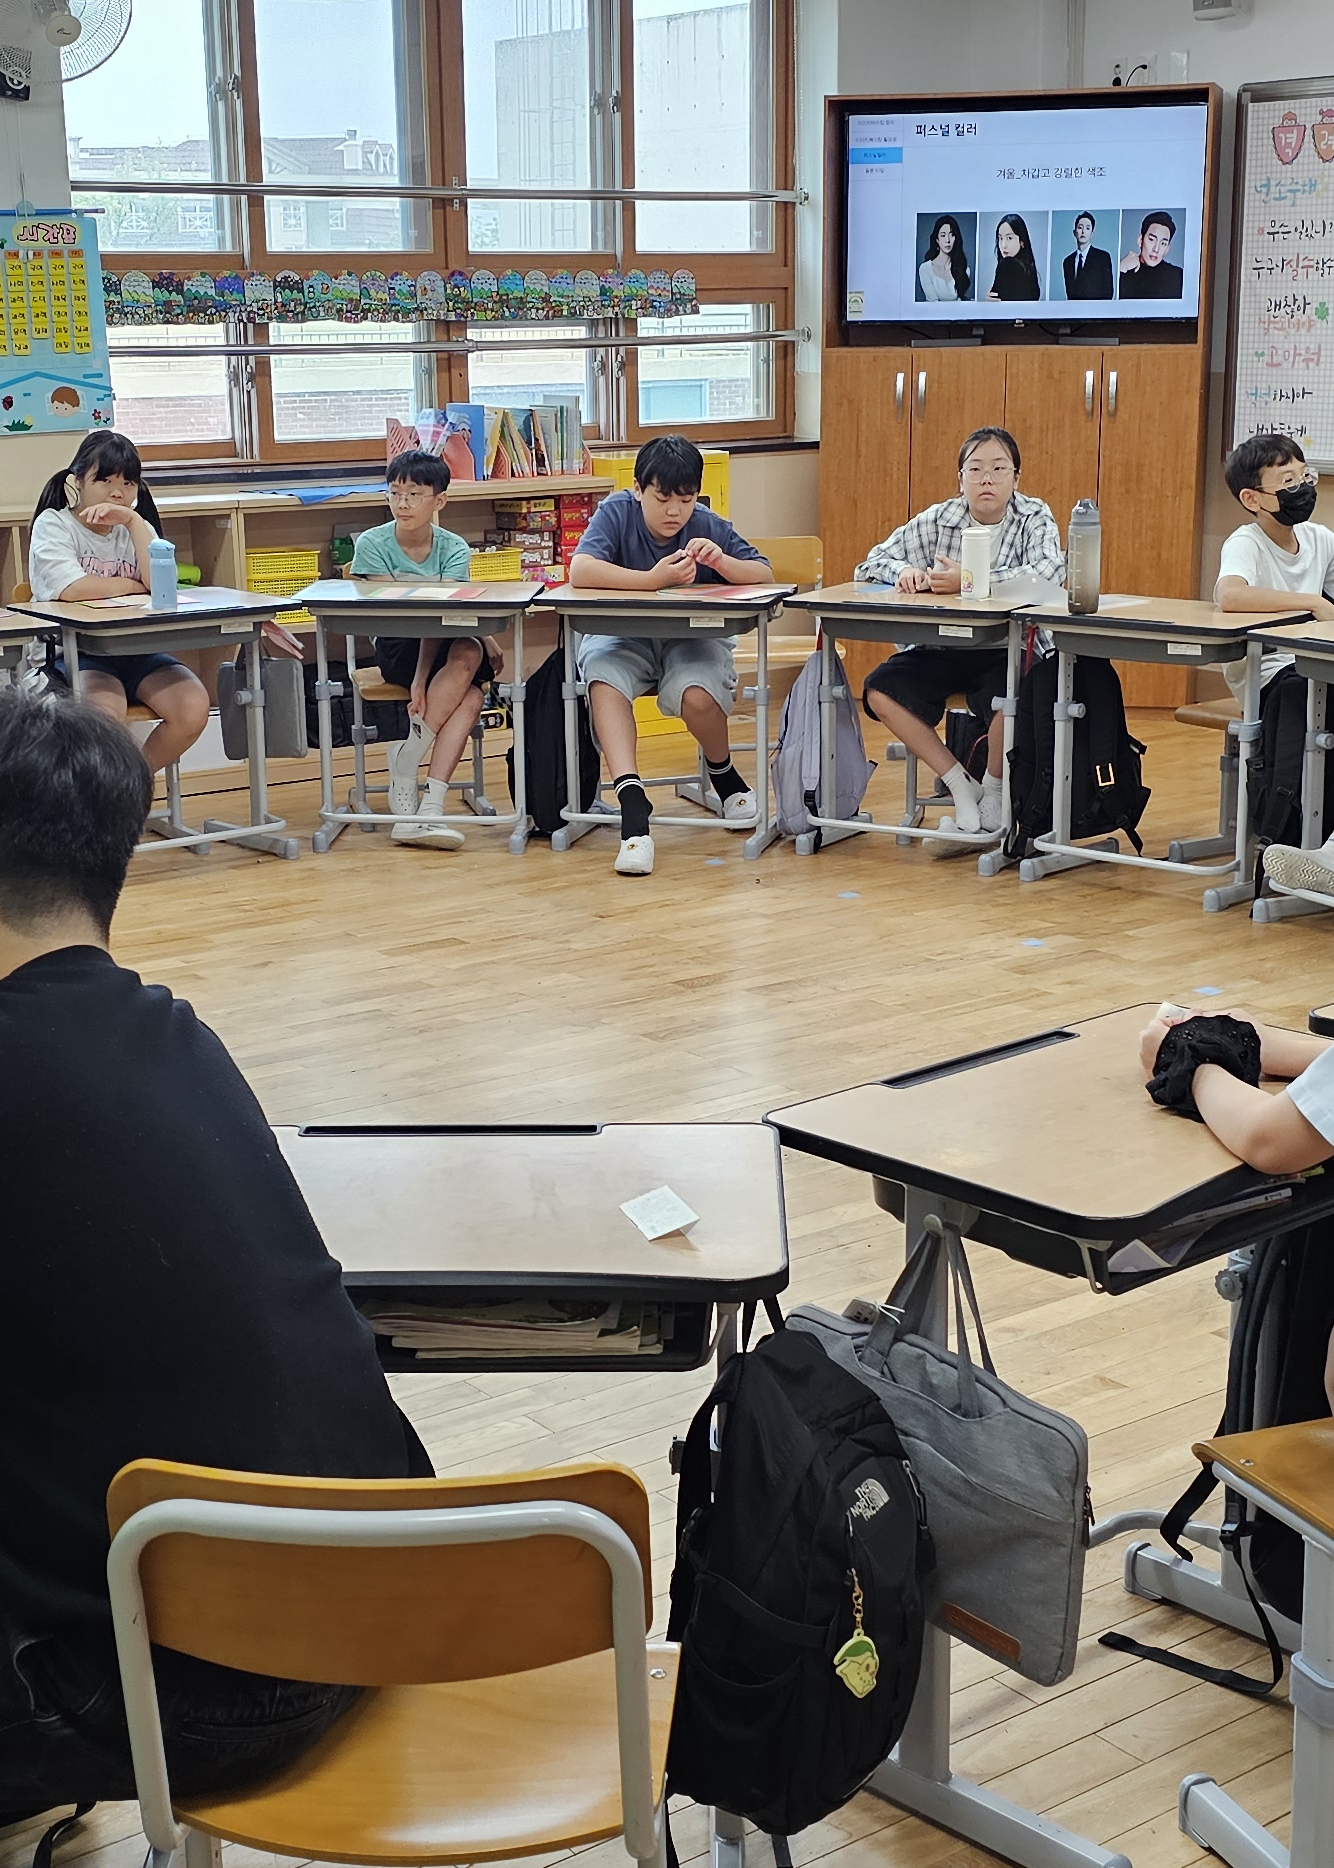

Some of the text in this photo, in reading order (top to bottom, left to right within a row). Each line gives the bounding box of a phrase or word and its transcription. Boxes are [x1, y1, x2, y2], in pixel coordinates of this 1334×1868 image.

[915, 122, 978, 137] 퍼스널 컬러
[1087, 167, 1106, 177] 색조
[1266, 293, 1311, 319] 괜찮아
[1266, 343, 1322, 370] 고마워
